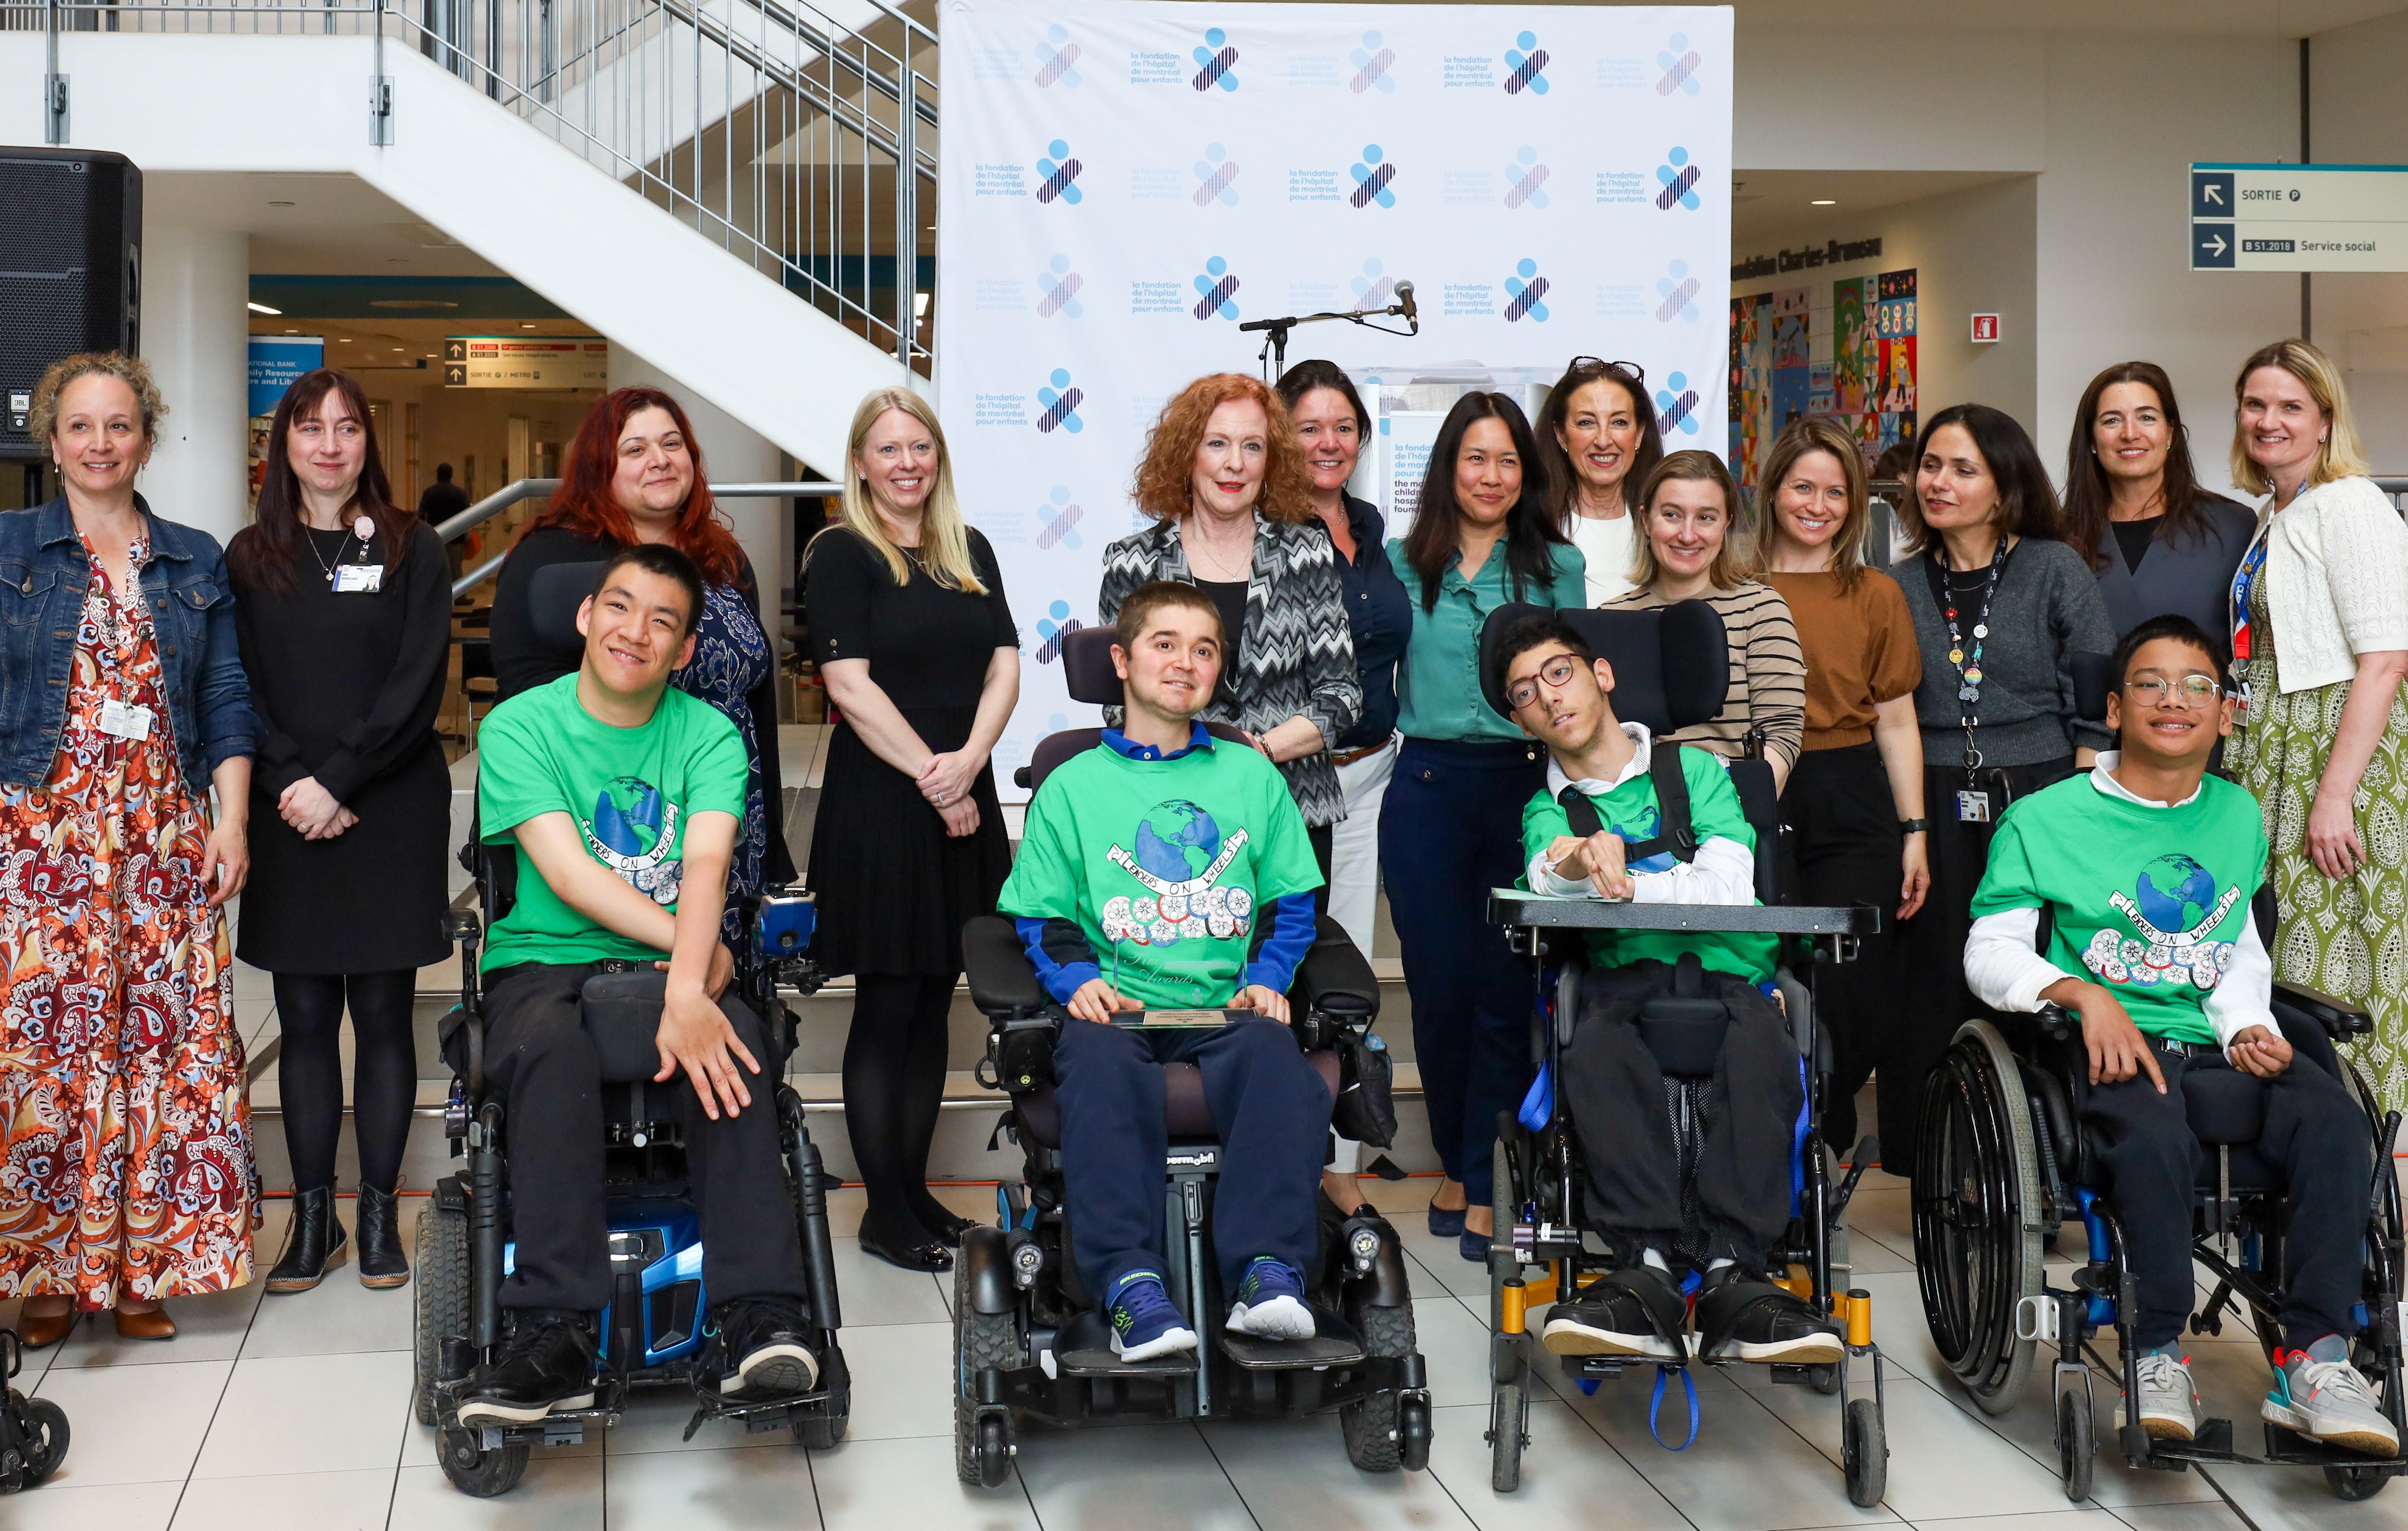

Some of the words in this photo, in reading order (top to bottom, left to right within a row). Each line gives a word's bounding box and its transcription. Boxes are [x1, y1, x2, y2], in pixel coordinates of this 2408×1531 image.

[1141, 52, 1180, 60] fondation
[1143, 60, 1175, 69] l'hôpital
[1456, 64, 1488, 73] l'hôpital
[985, 164, 1024, 172] fondation
[988, 172, 1020, 181] l'hôpital
[1302, 177, 1334, 186] l'hôpital
[1609, 179, 1640, 188] l'hôpital
[2242, 190, 2282, 200] SORTIE
[2245, 241, 2252, 251] B
[2254, 241, 2290, 251] S1.2018
[2301, 241, 2341, 251] Service
[2345, 241, 2376, 251] social
[1145, 289, 1177, 298] l'hôpital
[1456, 291, 1488, 301] l'hôpital
[988, 402, 1020, 411] l'hôpital
[586, 833, 612, 859] EADERS
[620, 857, 638, 869] ON
[1122, 857, 1159, 888] LEADERS
[1169, 883, 1191, 895] ON
[1203, 846, 1234, 885] WHEELS
[2126, 905, 2155, 937] LEADERS
[2158, 932, 2177, 945] ON
[2190, 902, 2228, 941] WHEELS
[1139, 965, 1193, 984] Awards
